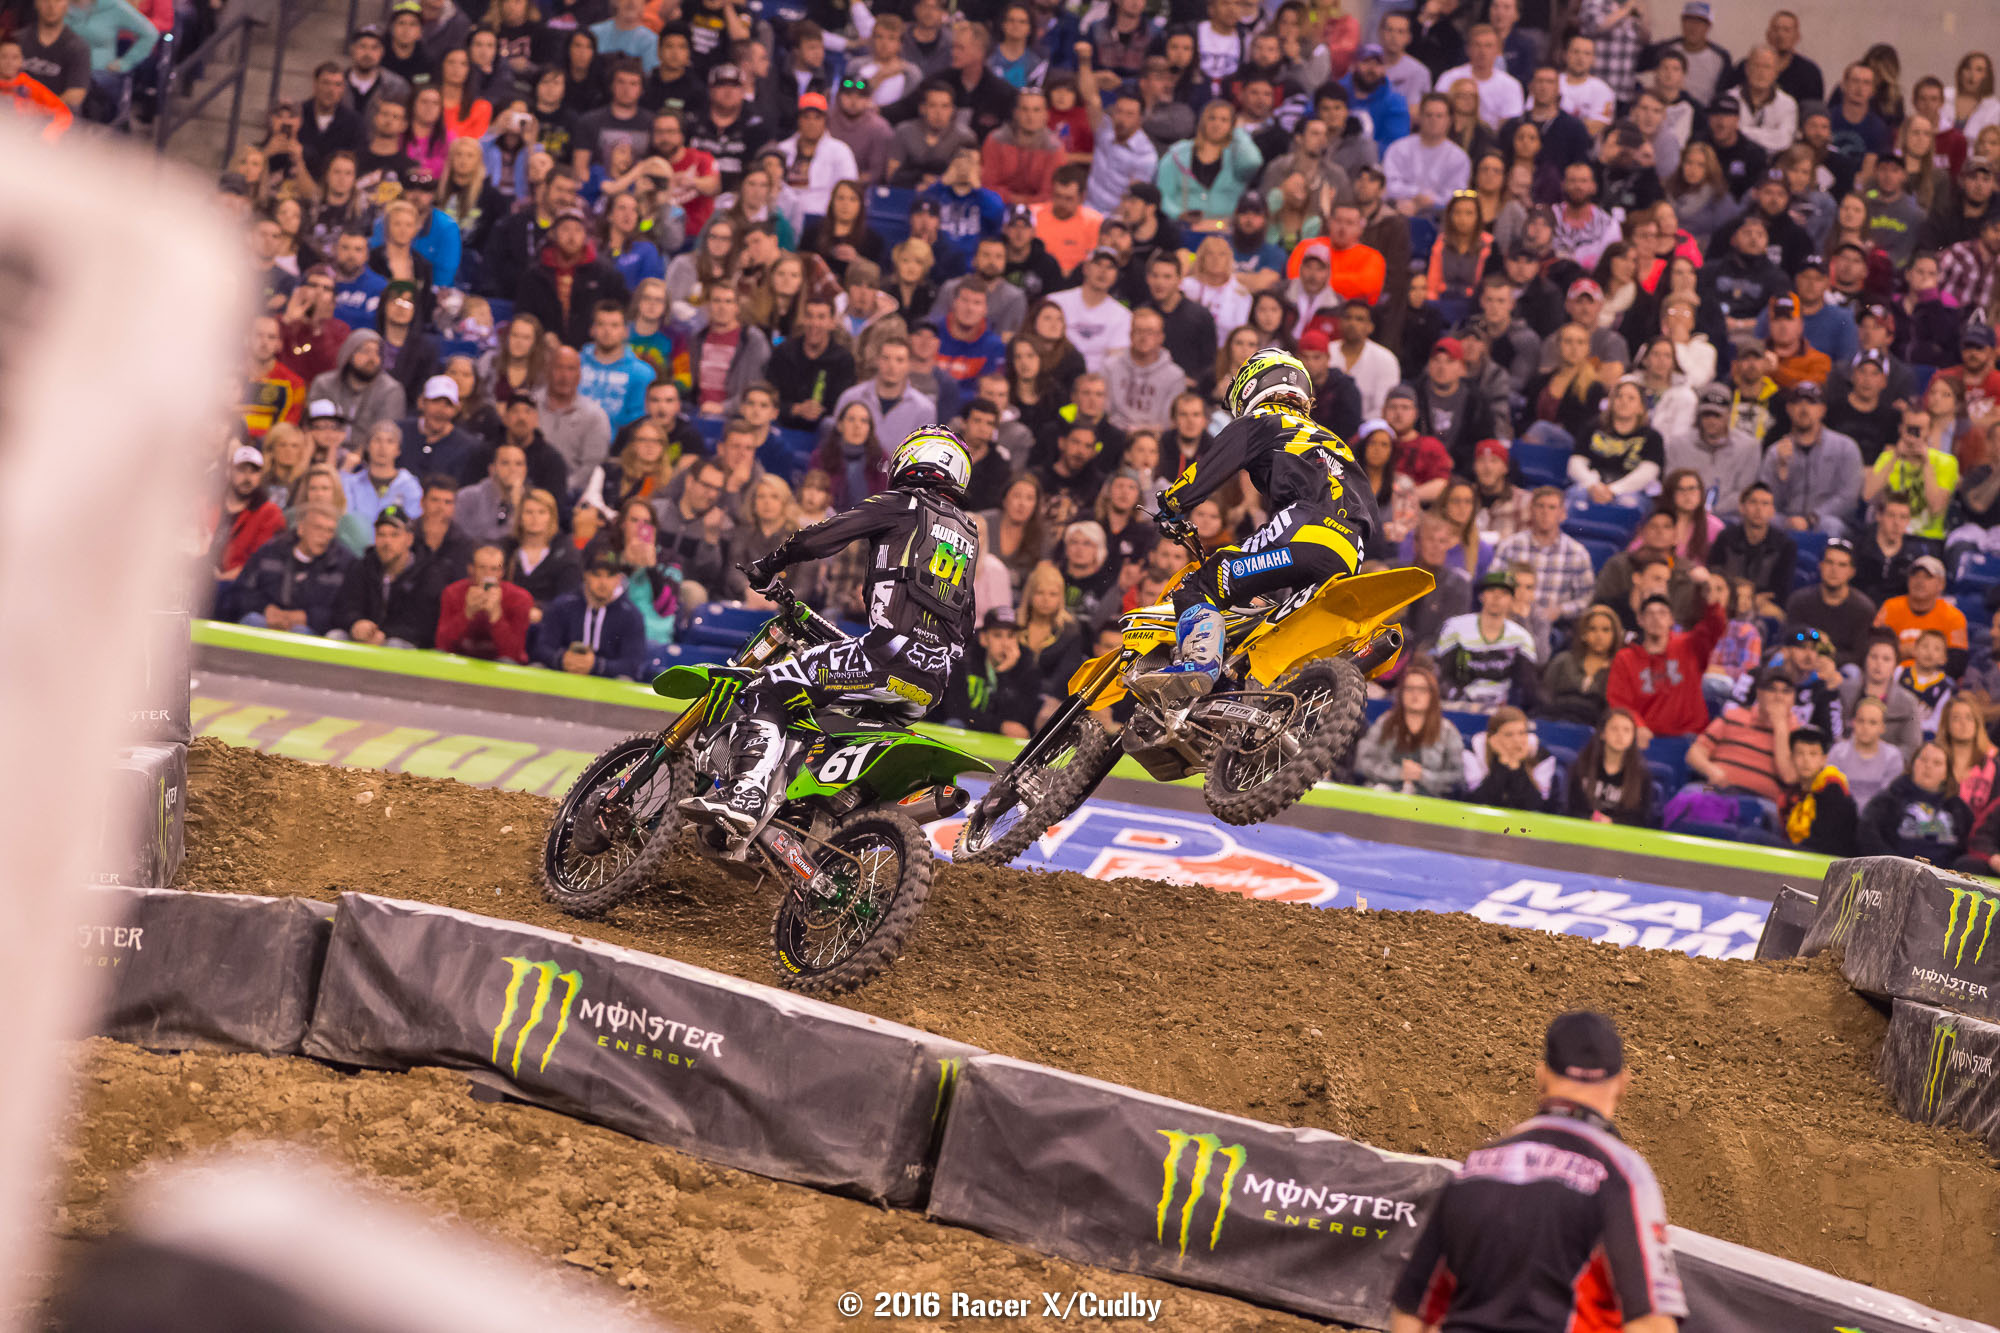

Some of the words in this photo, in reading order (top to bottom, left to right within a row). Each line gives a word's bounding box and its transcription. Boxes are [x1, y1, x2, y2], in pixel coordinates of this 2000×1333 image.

[930, 524, 975, 559] AUDETTE
[929, 542, 968, 587] 61
[1244, 550, 1292, 573] YAMAHA
[1124, 632, 1155, 640] YAMAHA
[829, 671, 868, 679] MONSTER
[1229, 707, 1250, 715] GYTR
[818, 742, 876, 783] 61
[1911, 966, 1988, 998] MONSTER
[579, 999, 725, 1058] MONSTER
[597, 1035, 695, 1069] ENERGY
[1243, 1173, 1417, 1228] MONSTER
[1264, 1209, 1388, 1239] ENERGY
